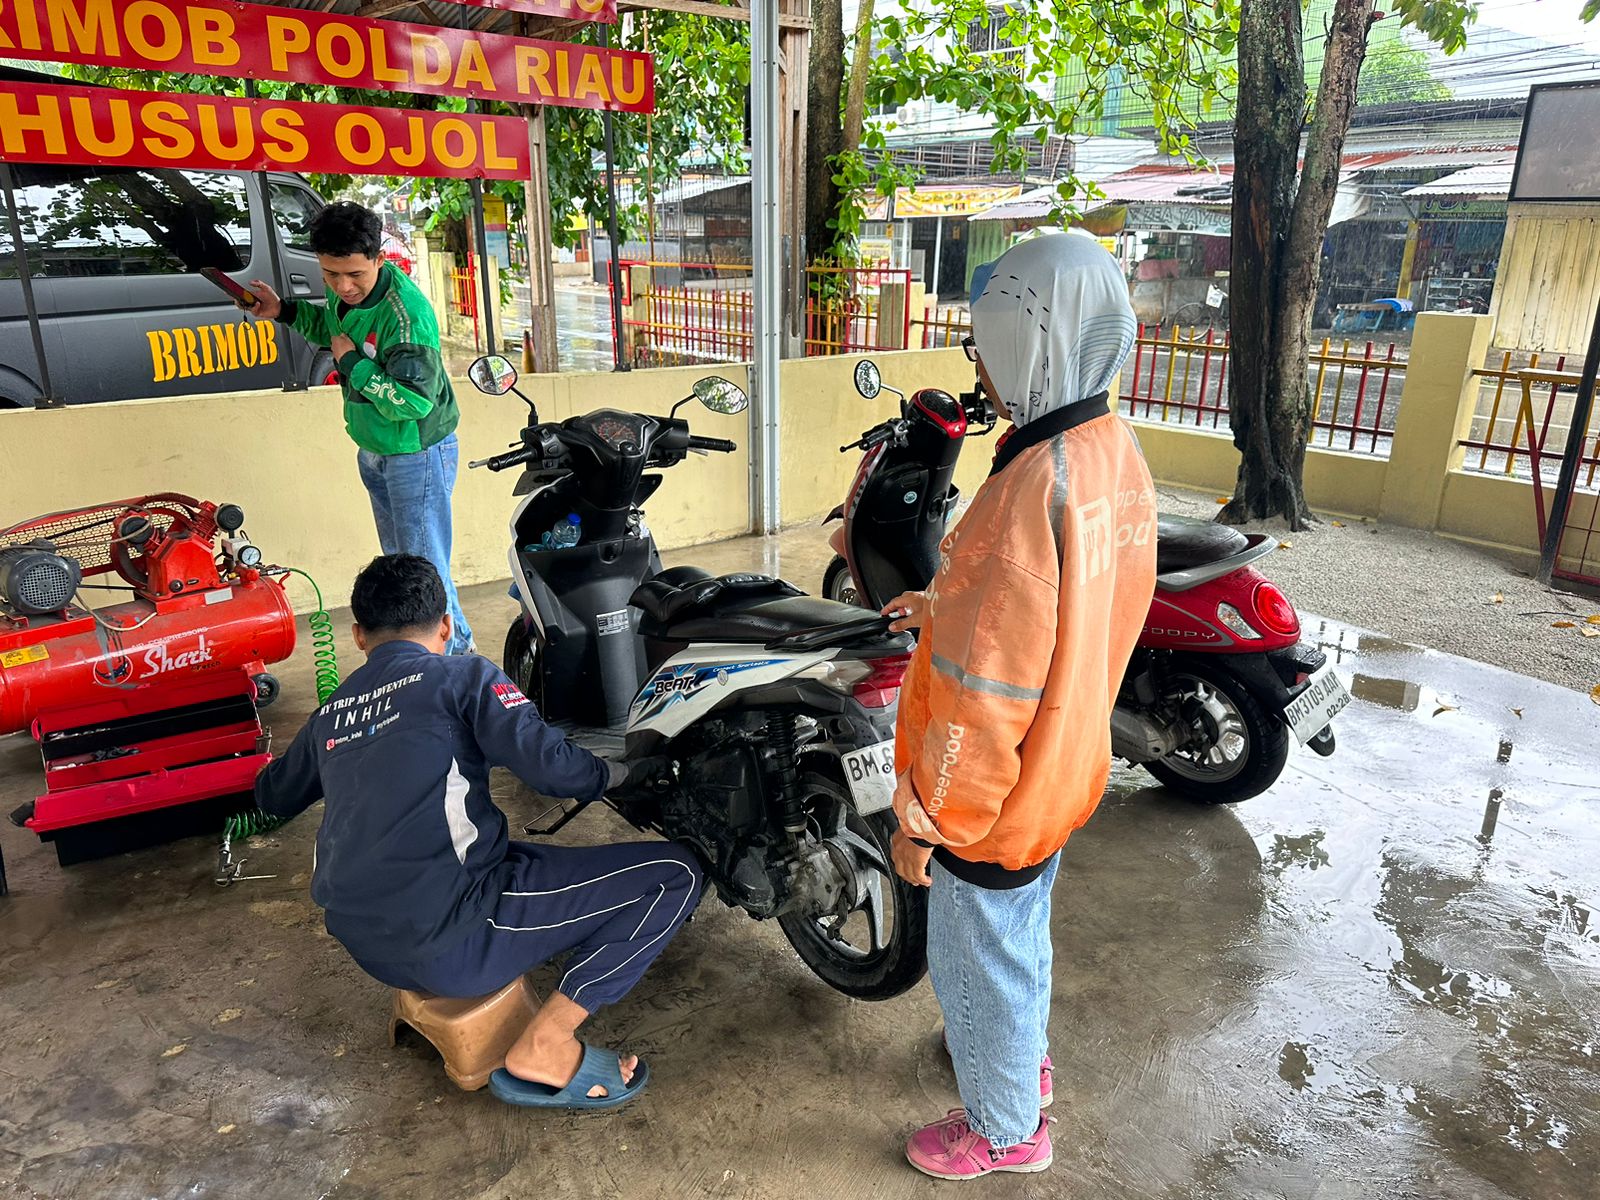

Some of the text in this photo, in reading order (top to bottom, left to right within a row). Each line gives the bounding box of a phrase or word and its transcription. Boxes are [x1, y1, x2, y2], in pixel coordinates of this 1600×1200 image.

[266, 15, 497, 92] POLDA
[514, 45, 646, 105] RIAU
[334, 112, 518, 170] OJOL
[146, 320, 278, 382] BRIMOB
[139, 634, 213, 679] Shark
[333, 697, 356, 711] TRIP
[356, 692, 372, 705] MY
[371, 673, 424, 699] ADVENTURE
[334, 697, 391, 730] INHIL
[1286, 702, 1305, 726] BM
[1300, 685, 1324, 715] 3109
[847, 752, 880, 782] BM
